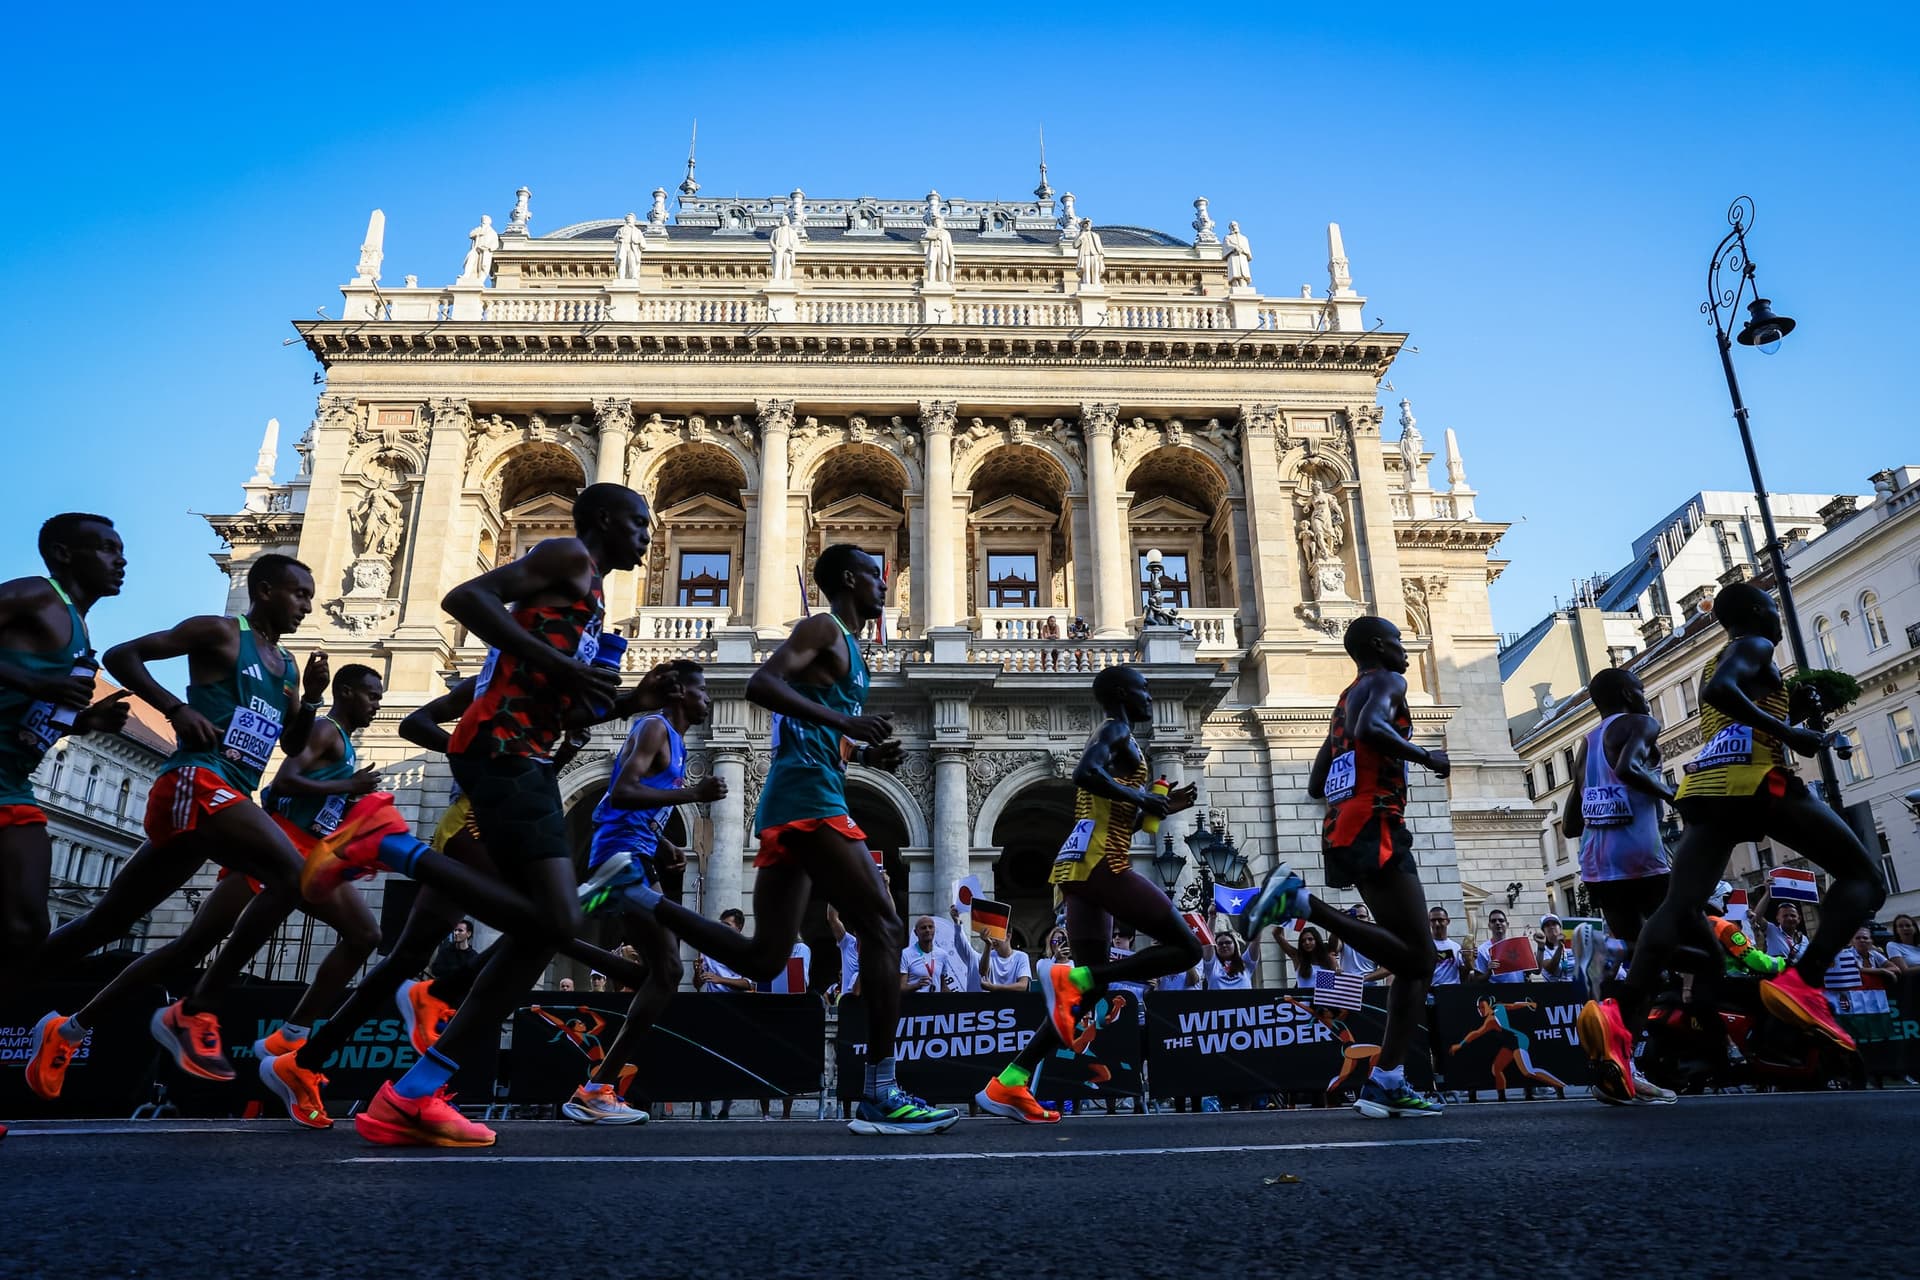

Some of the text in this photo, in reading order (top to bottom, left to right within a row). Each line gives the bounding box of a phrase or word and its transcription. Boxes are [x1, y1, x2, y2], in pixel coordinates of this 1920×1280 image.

[255, 715, 282, 739] TD
[229, 728, 270, 759] GEBRESIL
[1331, 751, 1353, 774] TDK
[1178, 1001, 1312, 1034] WITNESS
[1164, 1020, 1333, 1055] THE WONDER
[1534, 1029, 1562, 1041] THE
[231, 1045, 255, 1059] TH
